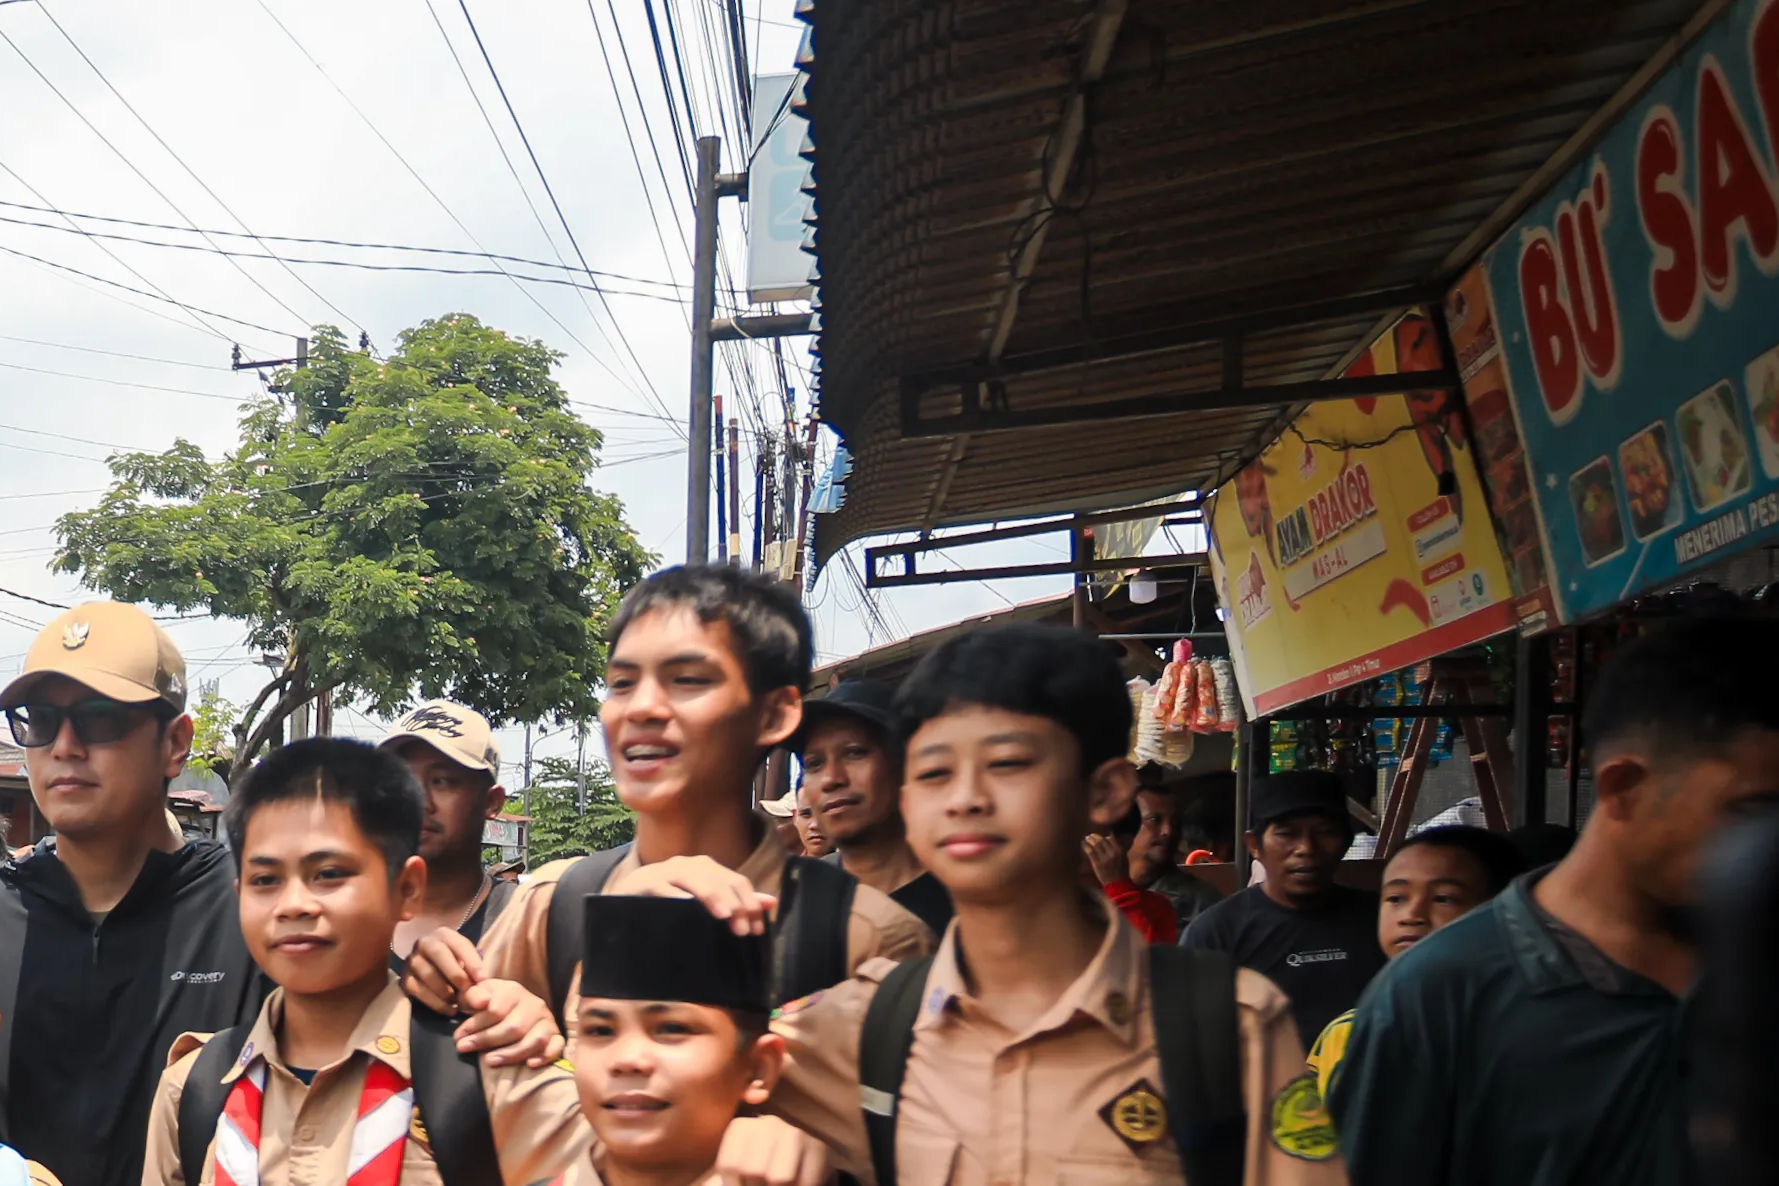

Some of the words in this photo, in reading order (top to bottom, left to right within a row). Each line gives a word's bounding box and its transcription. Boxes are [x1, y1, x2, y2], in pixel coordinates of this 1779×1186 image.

[1276, 505, 1313, 566] AYAM
[1307, 463, 1377, 542] DRAKOR
[1673, 508, 1748, 566] MENERIMA
[170, 971, 225, 982] Dicovery
